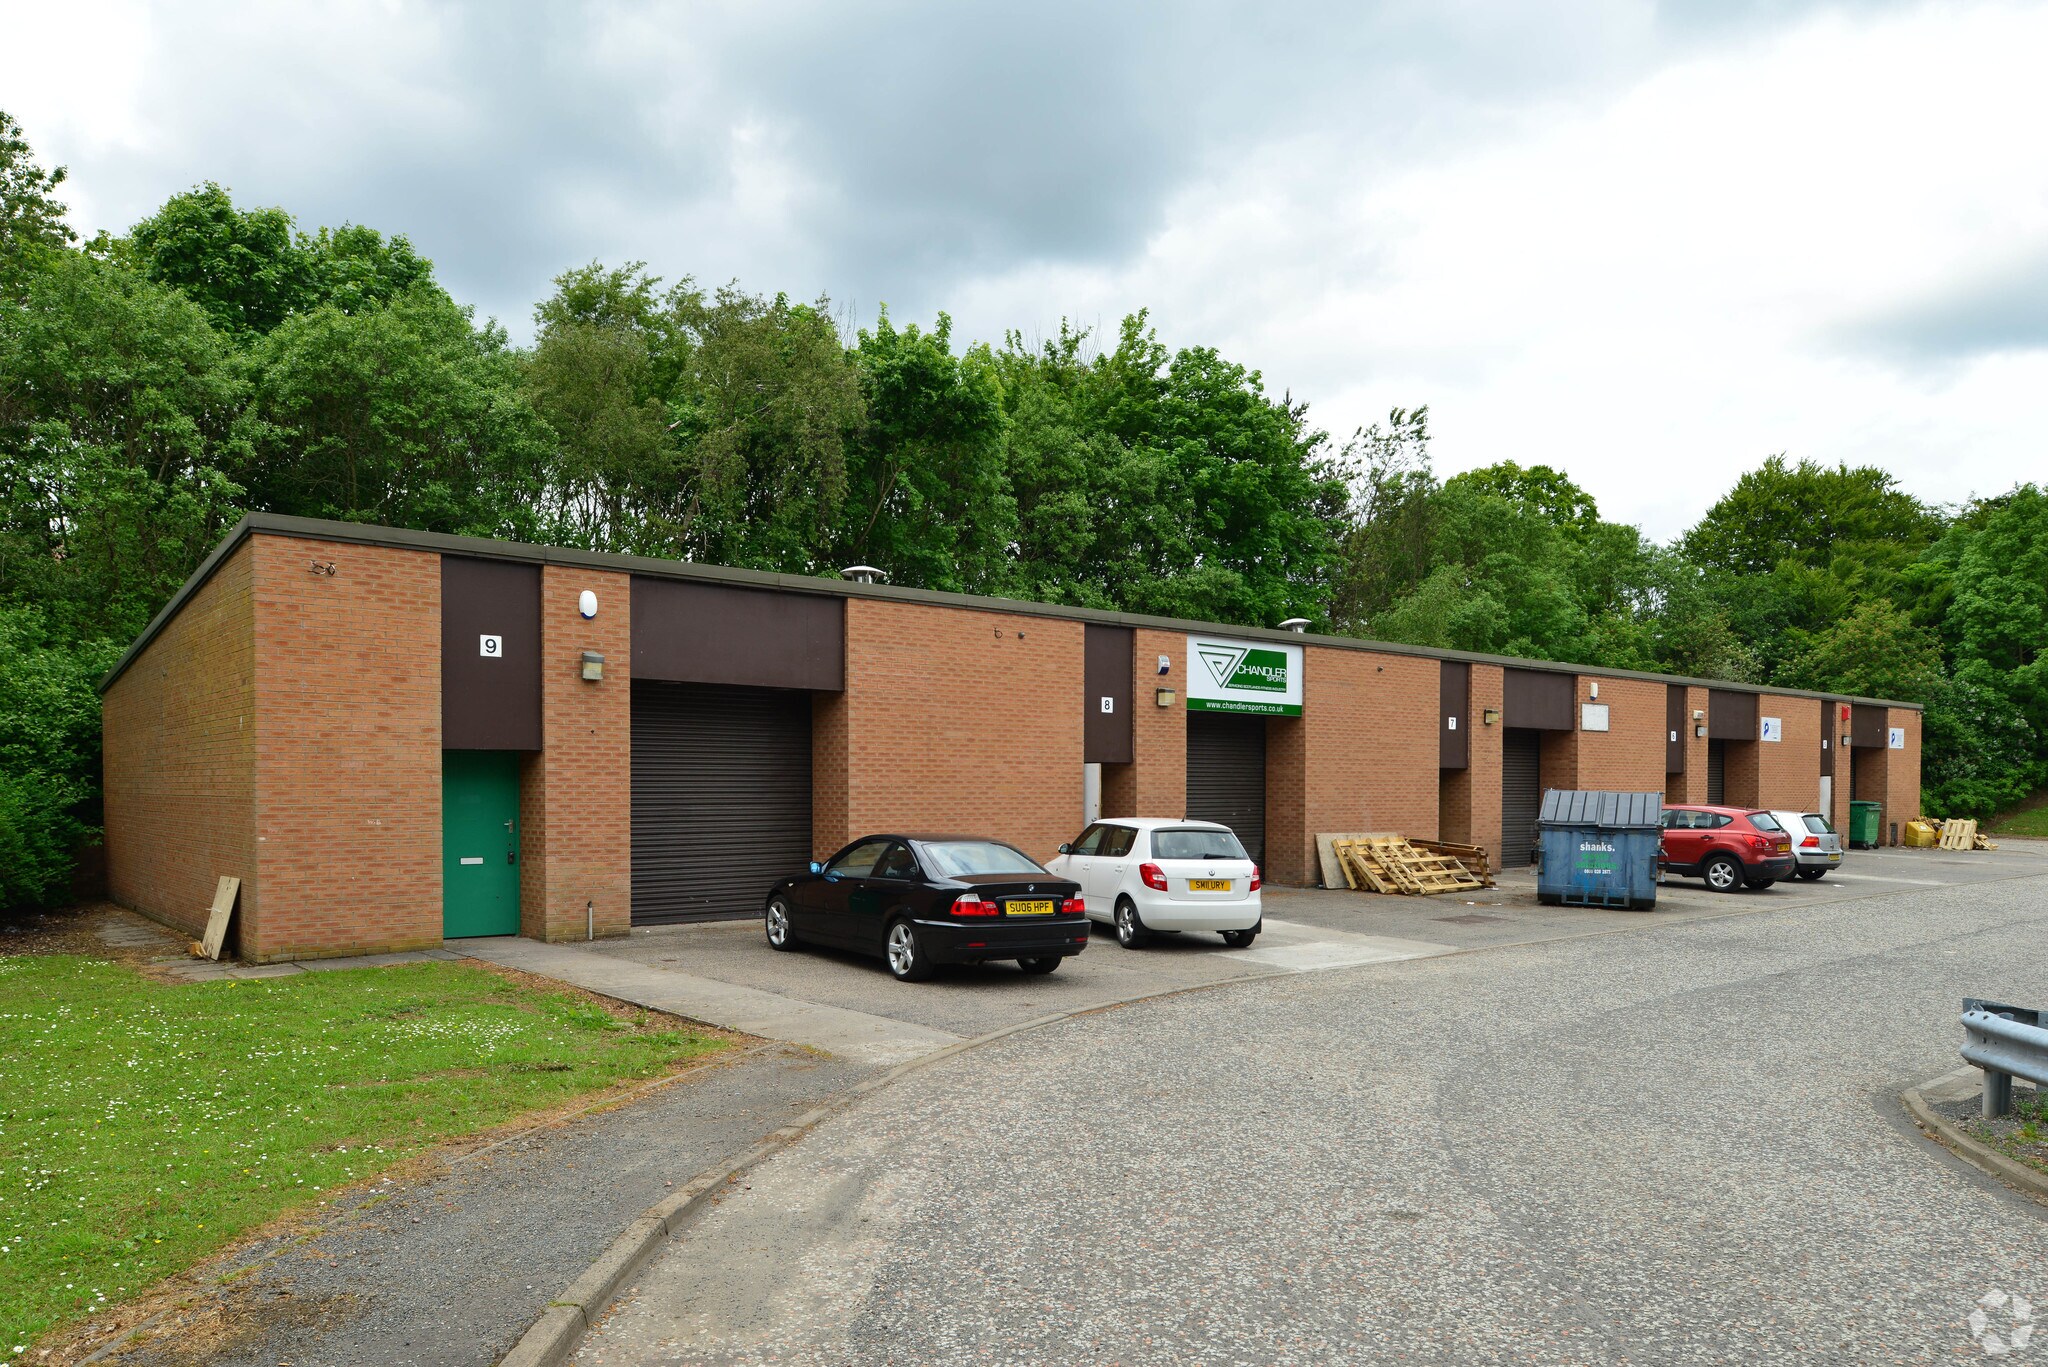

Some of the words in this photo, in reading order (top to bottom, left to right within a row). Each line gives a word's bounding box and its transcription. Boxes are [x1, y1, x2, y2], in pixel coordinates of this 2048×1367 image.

[485, 638, 497, 654] 9
[1238, 664, 1287, 677] CHANDLER
[1266, 675, 1287, 683] SPORTS
[1104, 699, 1110, 710] 8
[1206, 701, 1284, 712] www.chandlersports.co.uk
[1450, 718, 1455, 728] 7
[1580, 841, 1616, 852] shanks.
[1210, 880, 1225, 889] URY
[1010, 902, 1032, 912] SU06
[1033, 902, 1050, 912] HPF
